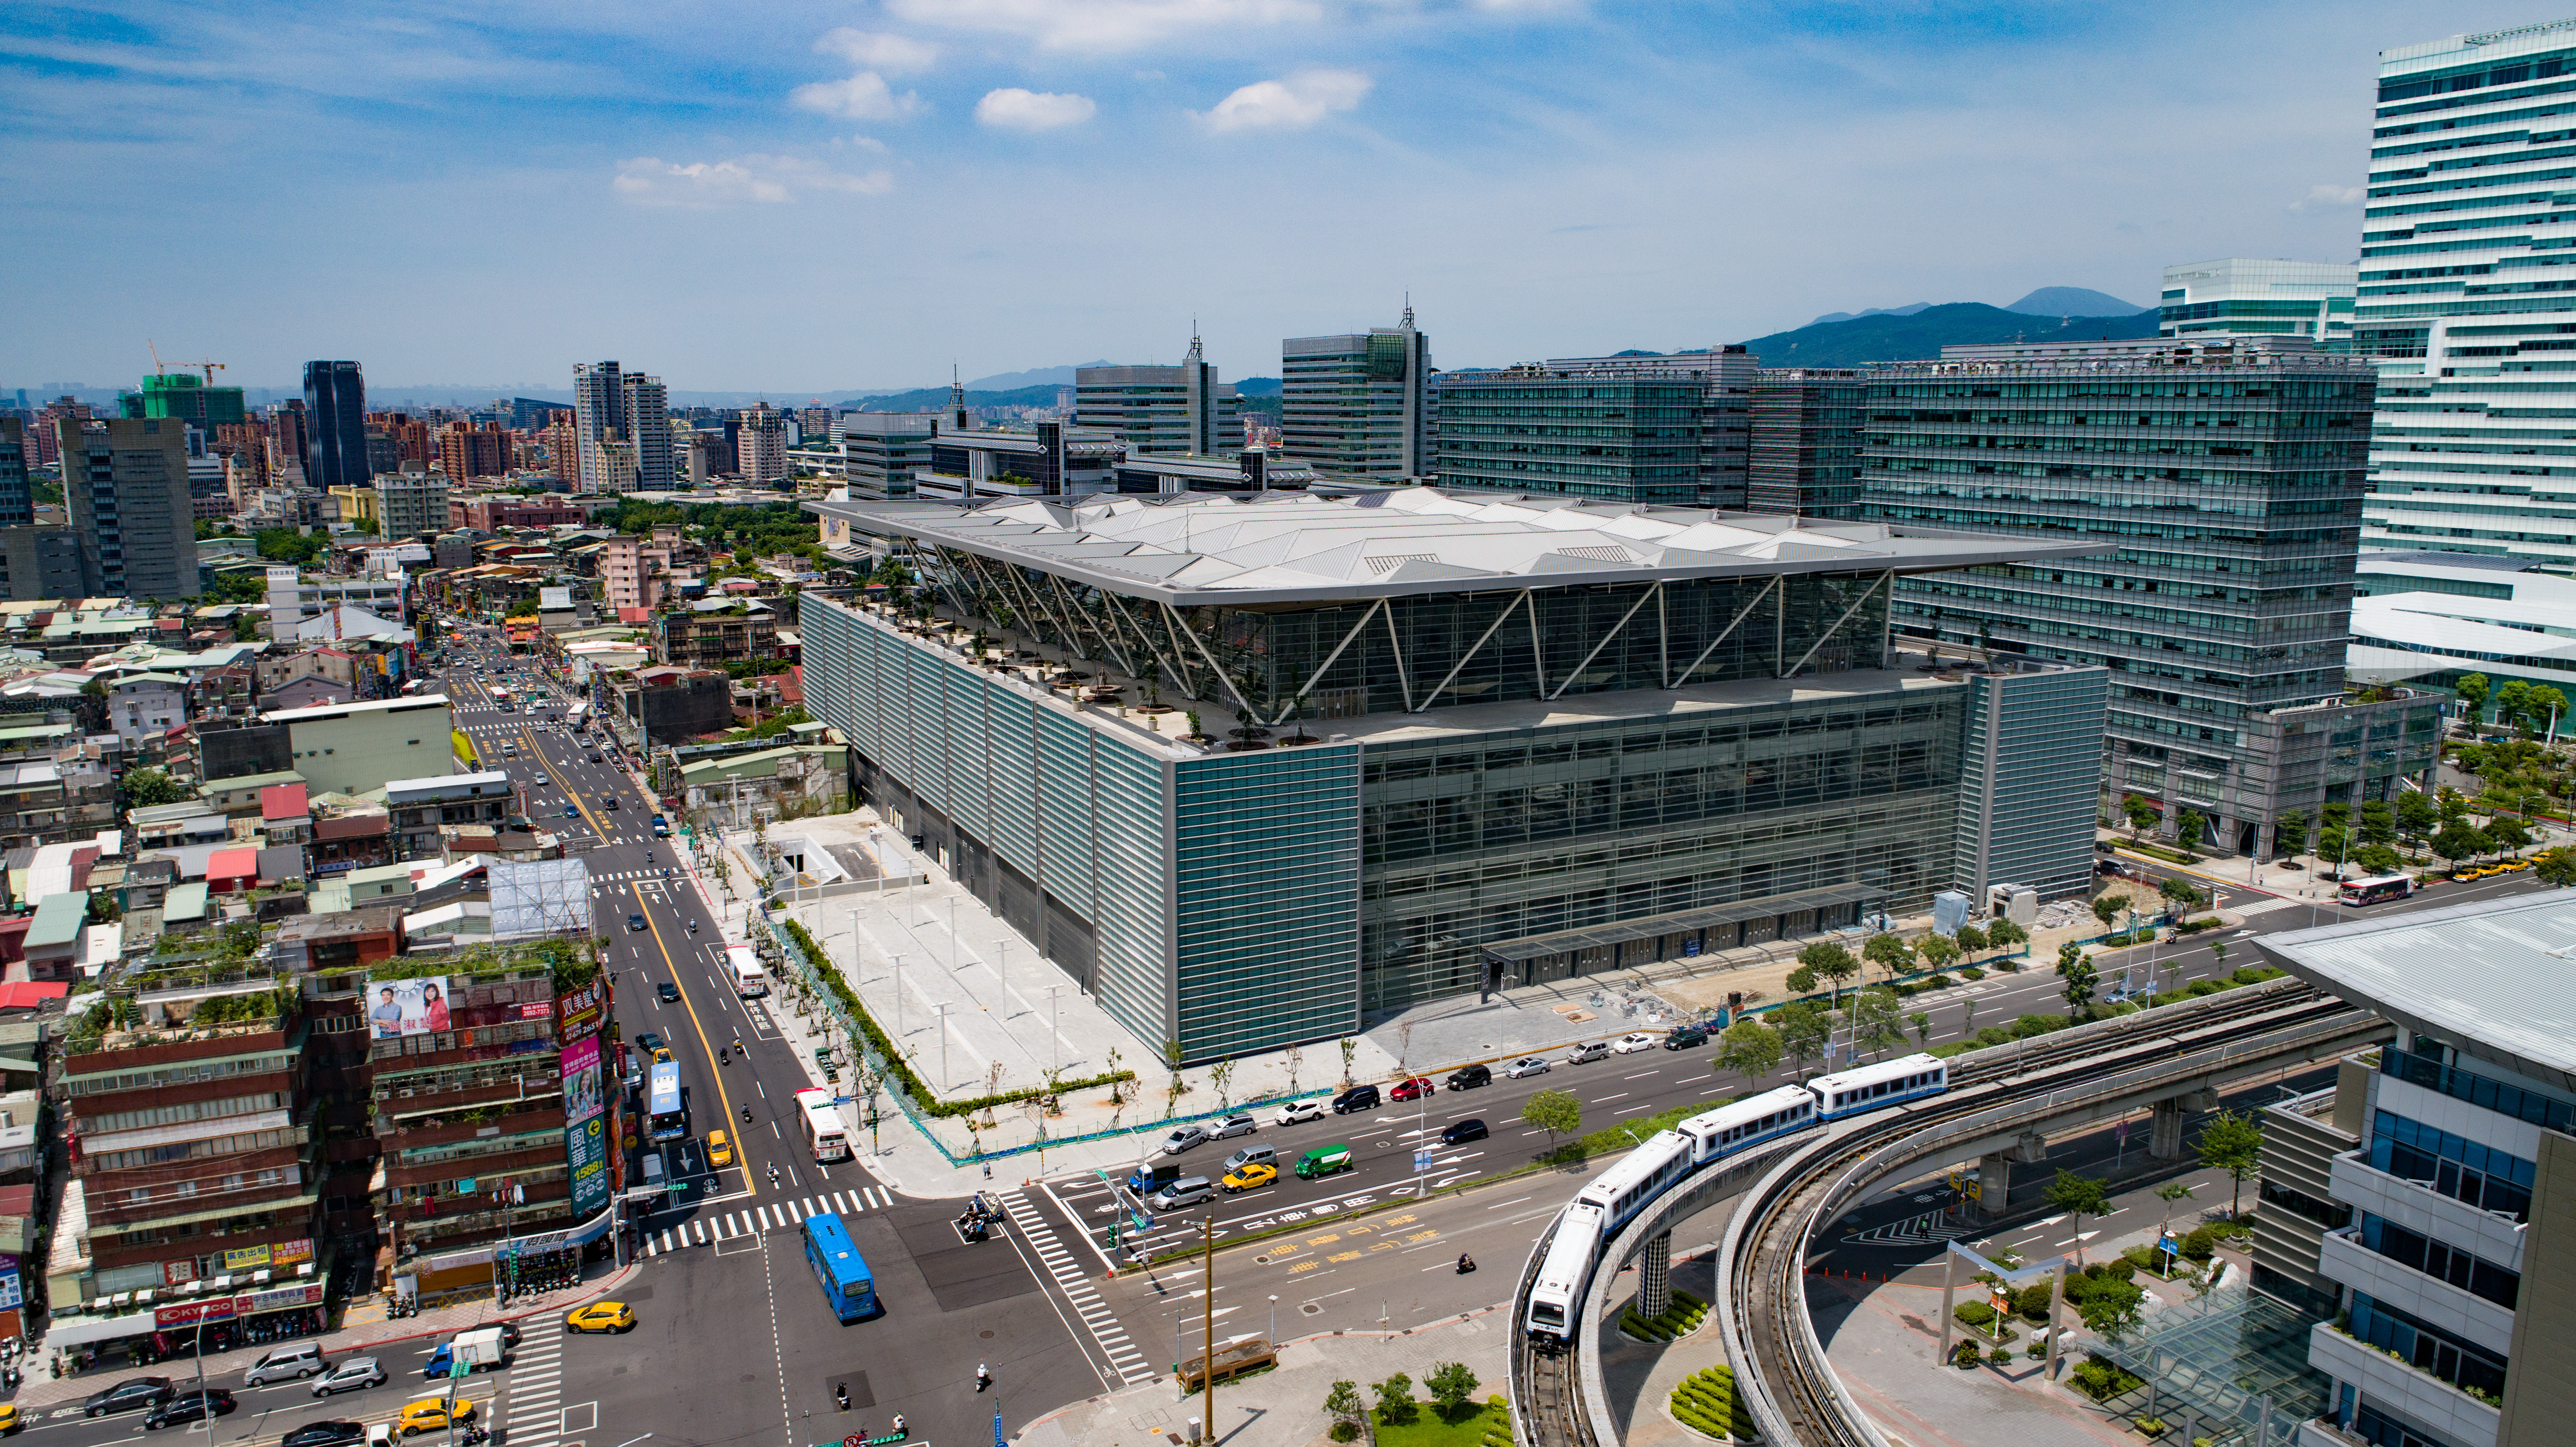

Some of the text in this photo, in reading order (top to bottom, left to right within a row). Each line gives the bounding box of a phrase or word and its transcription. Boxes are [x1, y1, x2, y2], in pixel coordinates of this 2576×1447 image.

[523, 1008, 550, 1016] 2692-7373
[570, 1127, 588, 1168] 風華
[574, 1160, 599, 1181] 1588
[1243, 1195, 1377, 1230] 公車專用
[1268, 1214, 1418, 1256] 禁行機車
[227, 1246, 267, 1260] 廣告出租
[1288, 1230, 1440, 1273] 禁行機車
[168, 1261, 193, 1281] 租
[7, 1275, 20, 1304] 李明賢
[253, 1288, 304, 1303] 中古機車買賣
